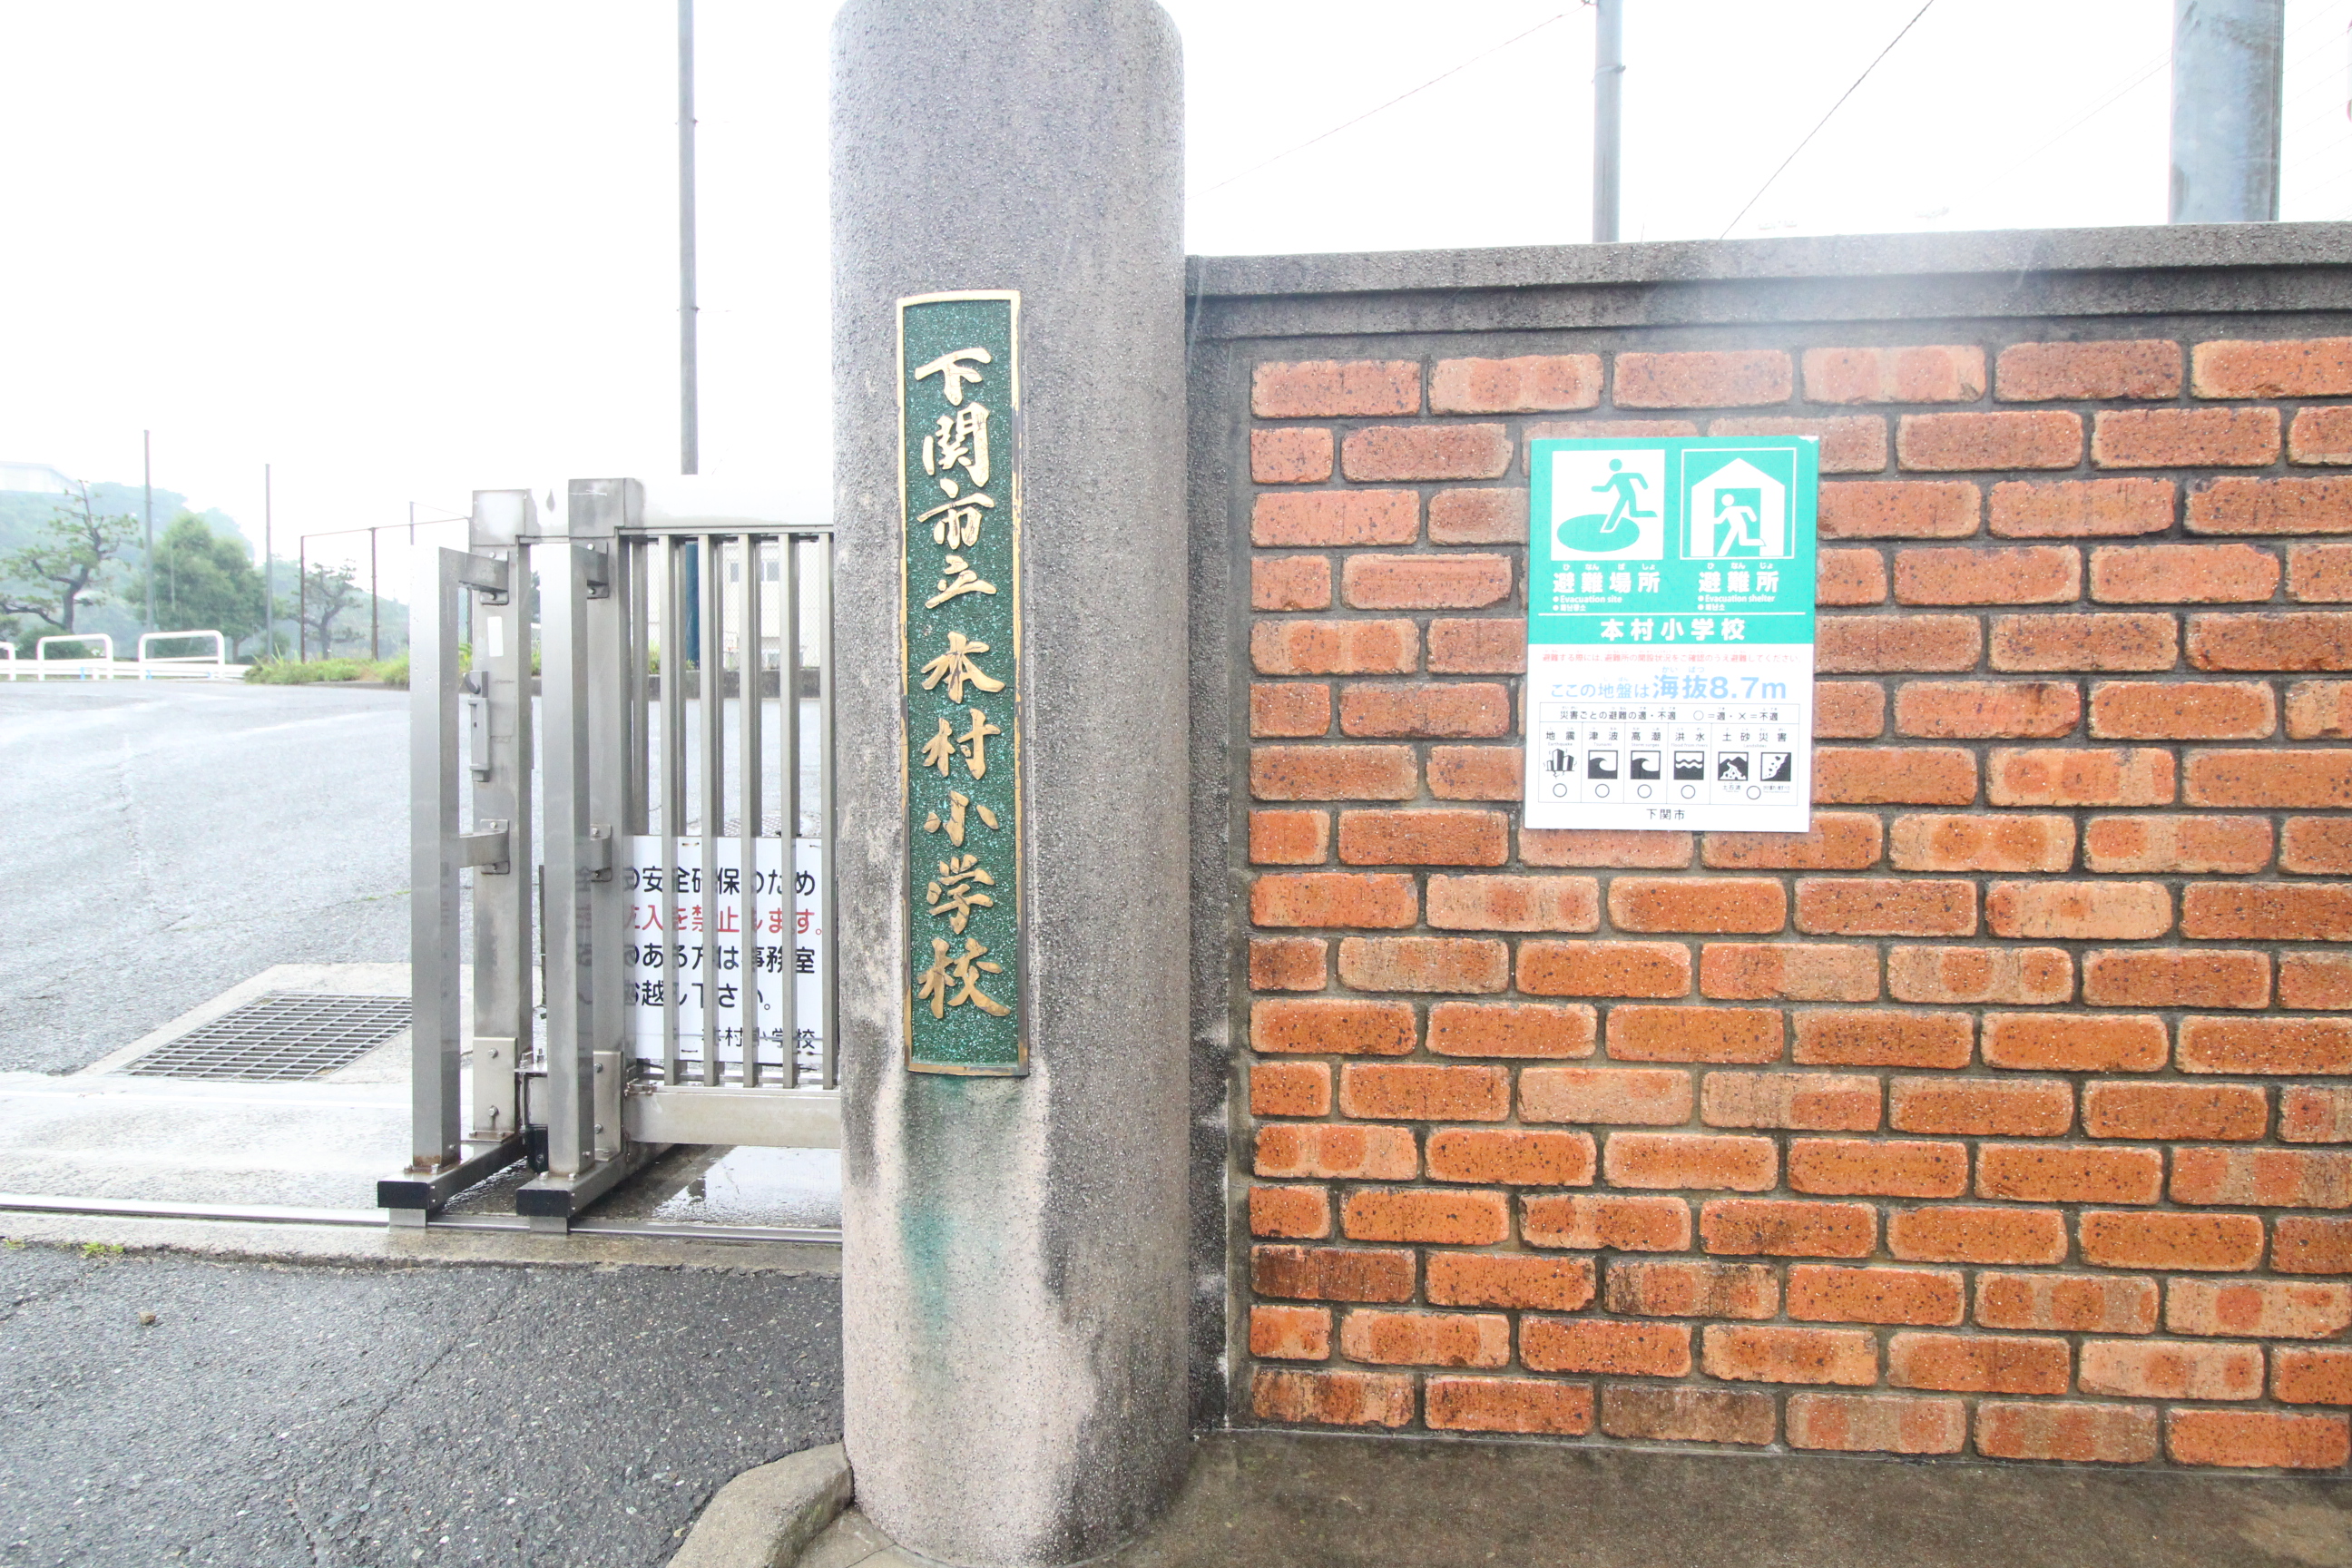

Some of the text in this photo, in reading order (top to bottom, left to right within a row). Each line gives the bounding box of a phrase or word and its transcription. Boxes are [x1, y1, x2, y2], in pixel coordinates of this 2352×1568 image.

[1553, 572, 1661, 593] 避難場所
[1699, 571, 1779, 593] 避難所
[1560, 595, 1622, 603] Evacuation site
[1705, 594, 1775, 603] Evacuation shelter
[1601, 618, 1745, 641] 本村小学校
[914, 347, 1010, 1019] 下関市立本村小学校
[1551, 674, 1787, 700] ここの地盤は海抜8.7m
[1545, 730, 1575, 741] 地震
[1588, 731, 1618, 741] 津波
[1631, 731, 1661, 741] 高潮
[1675, 731, 1705, 742] 洪水
[1722, 731, 1787, 742] 土砂災害
[1646, 808, 1685, 821] 下関市
